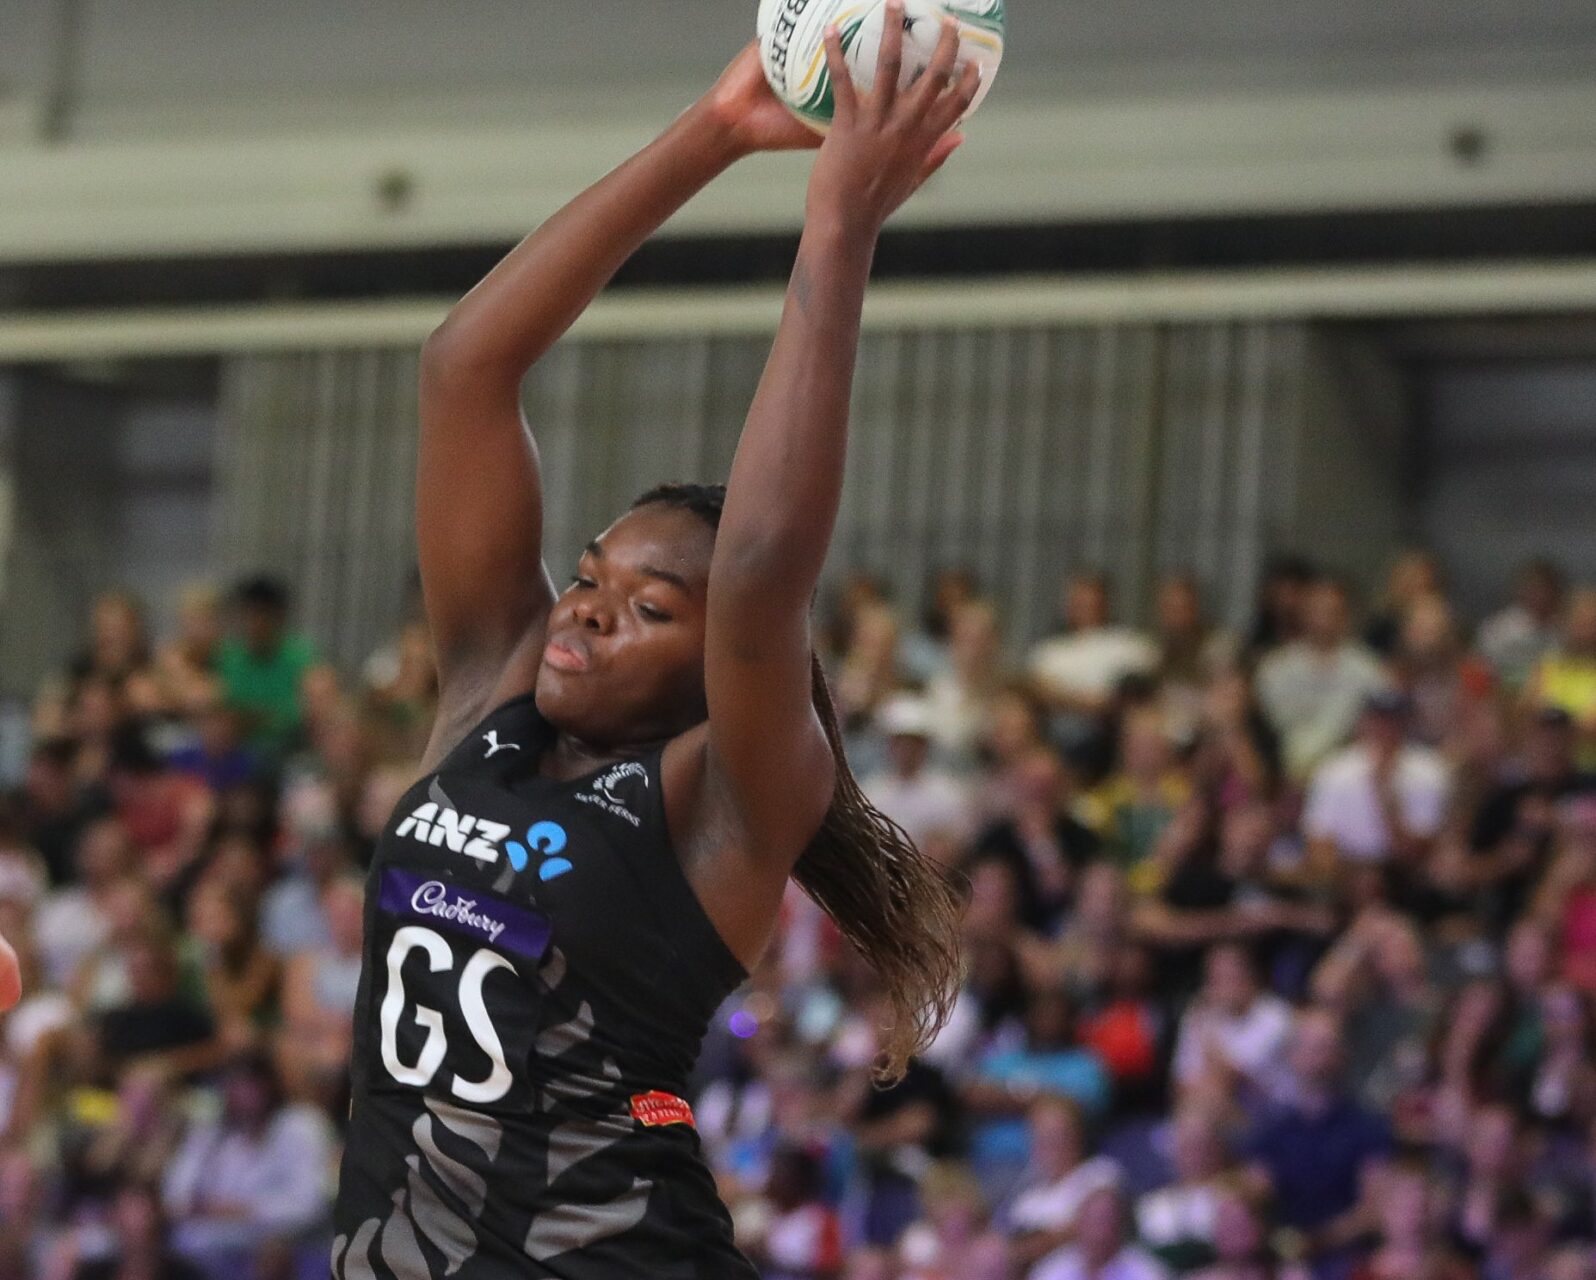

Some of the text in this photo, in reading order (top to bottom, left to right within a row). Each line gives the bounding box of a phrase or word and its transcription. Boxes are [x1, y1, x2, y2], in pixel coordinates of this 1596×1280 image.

[396, 802, 511, 863] ANZ
[411, 880, 505, 943] Cadbury
[380, 926, 518, 1102] GS
